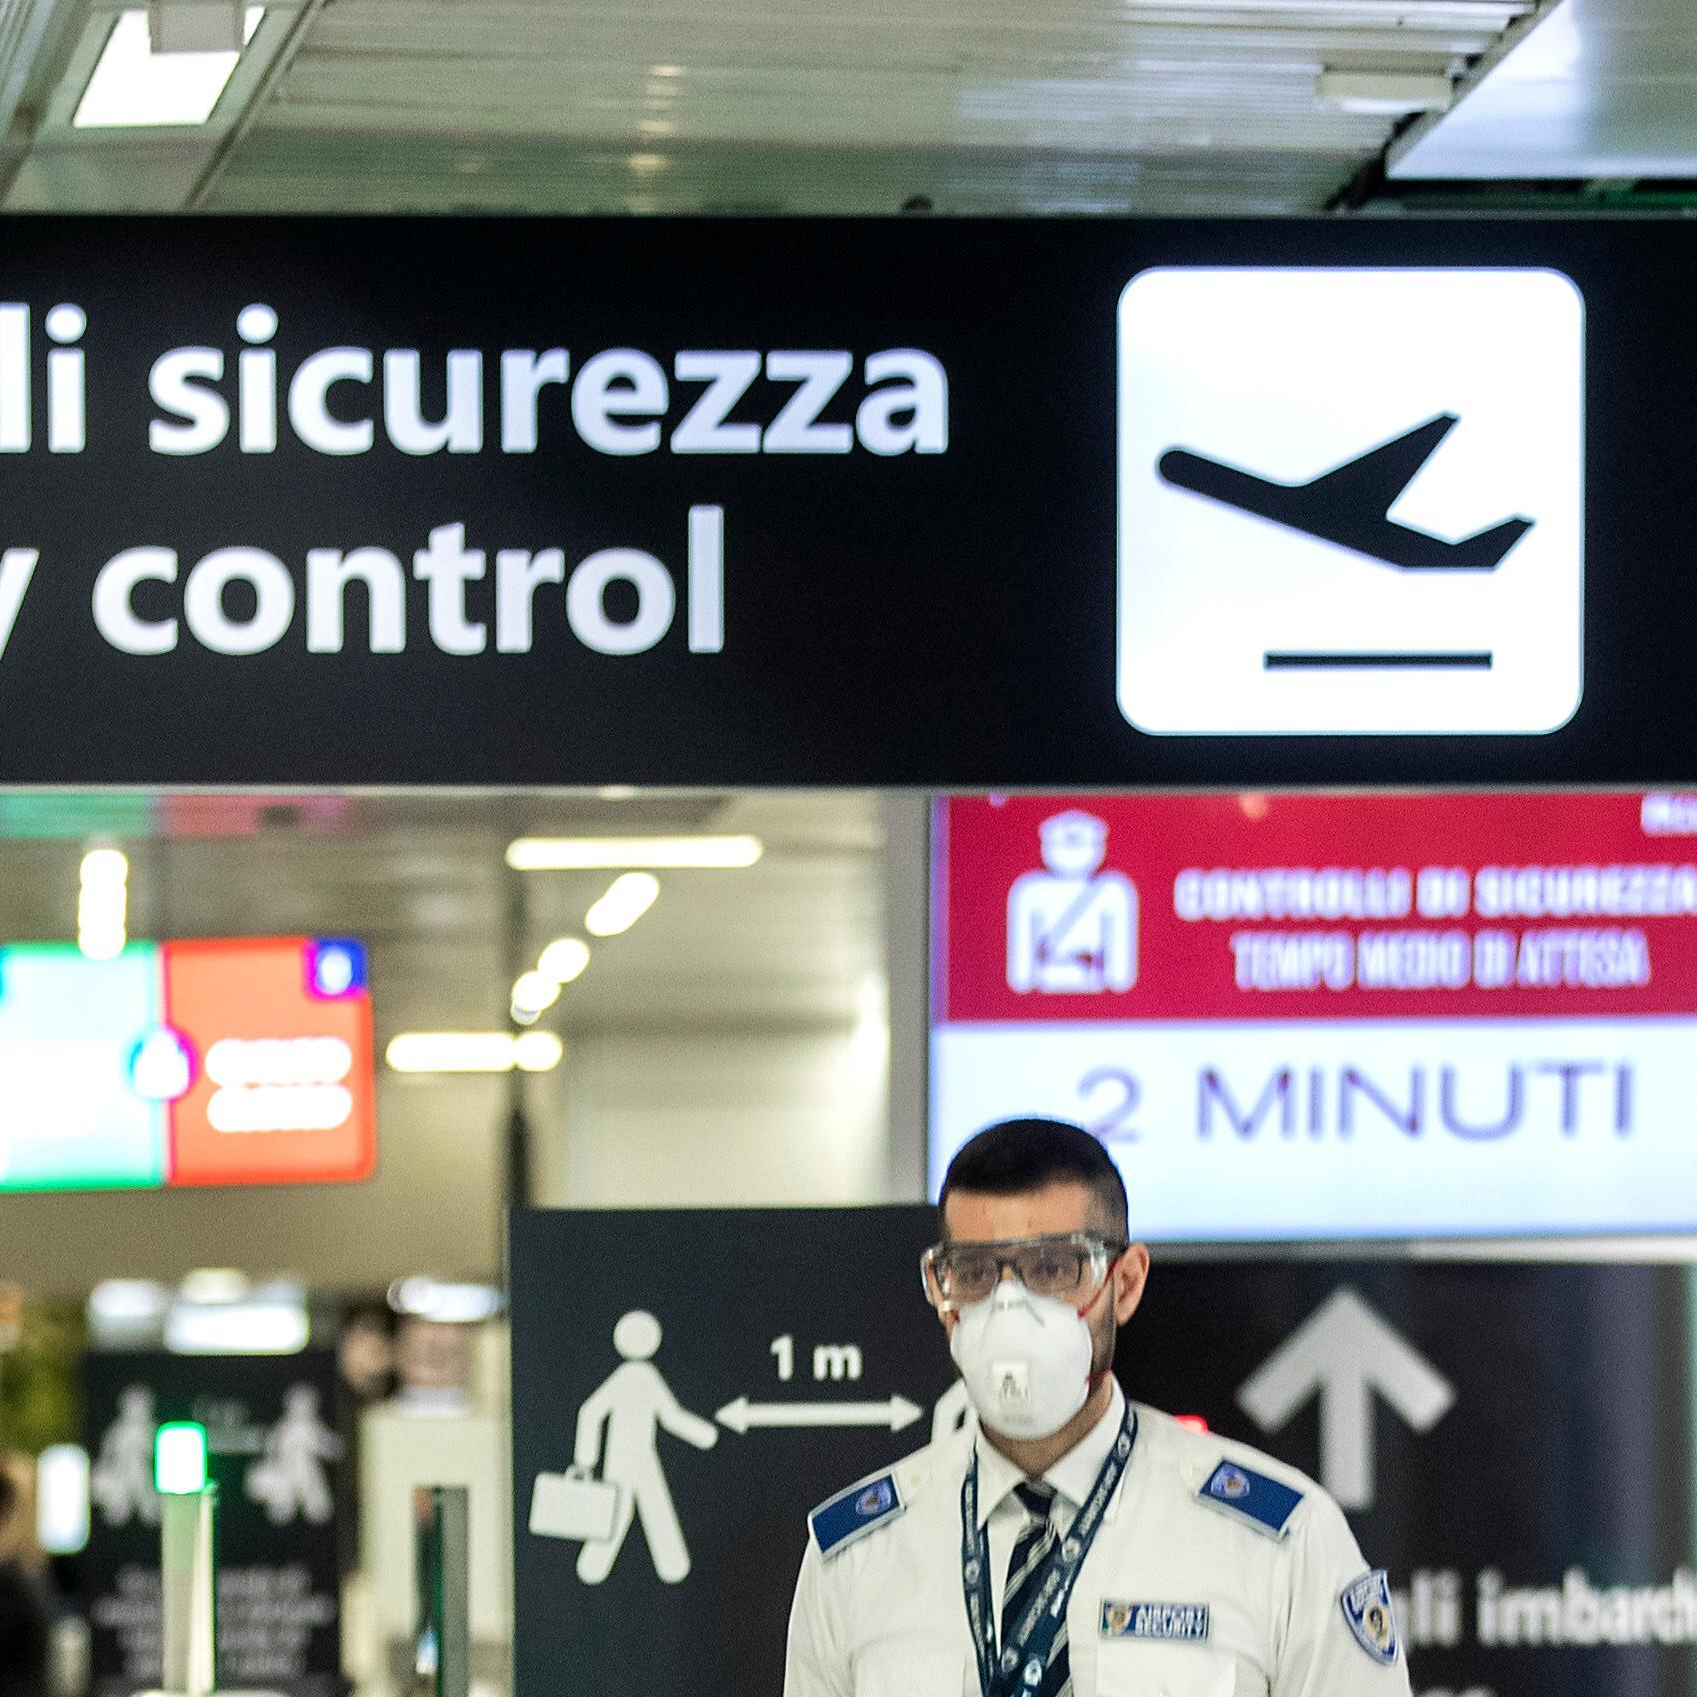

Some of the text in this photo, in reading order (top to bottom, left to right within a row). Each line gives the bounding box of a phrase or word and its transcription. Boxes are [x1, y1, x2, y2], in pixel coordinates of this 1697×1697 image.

[148, 304, 948, 455] sicurezza
[92, 506, 723, 655] control
[1416, 867, 1470, 917] DI
[1076, 1061, 1635, 1145] 2 MINUTI
[771, 1336, 861, 1380] 1 m
